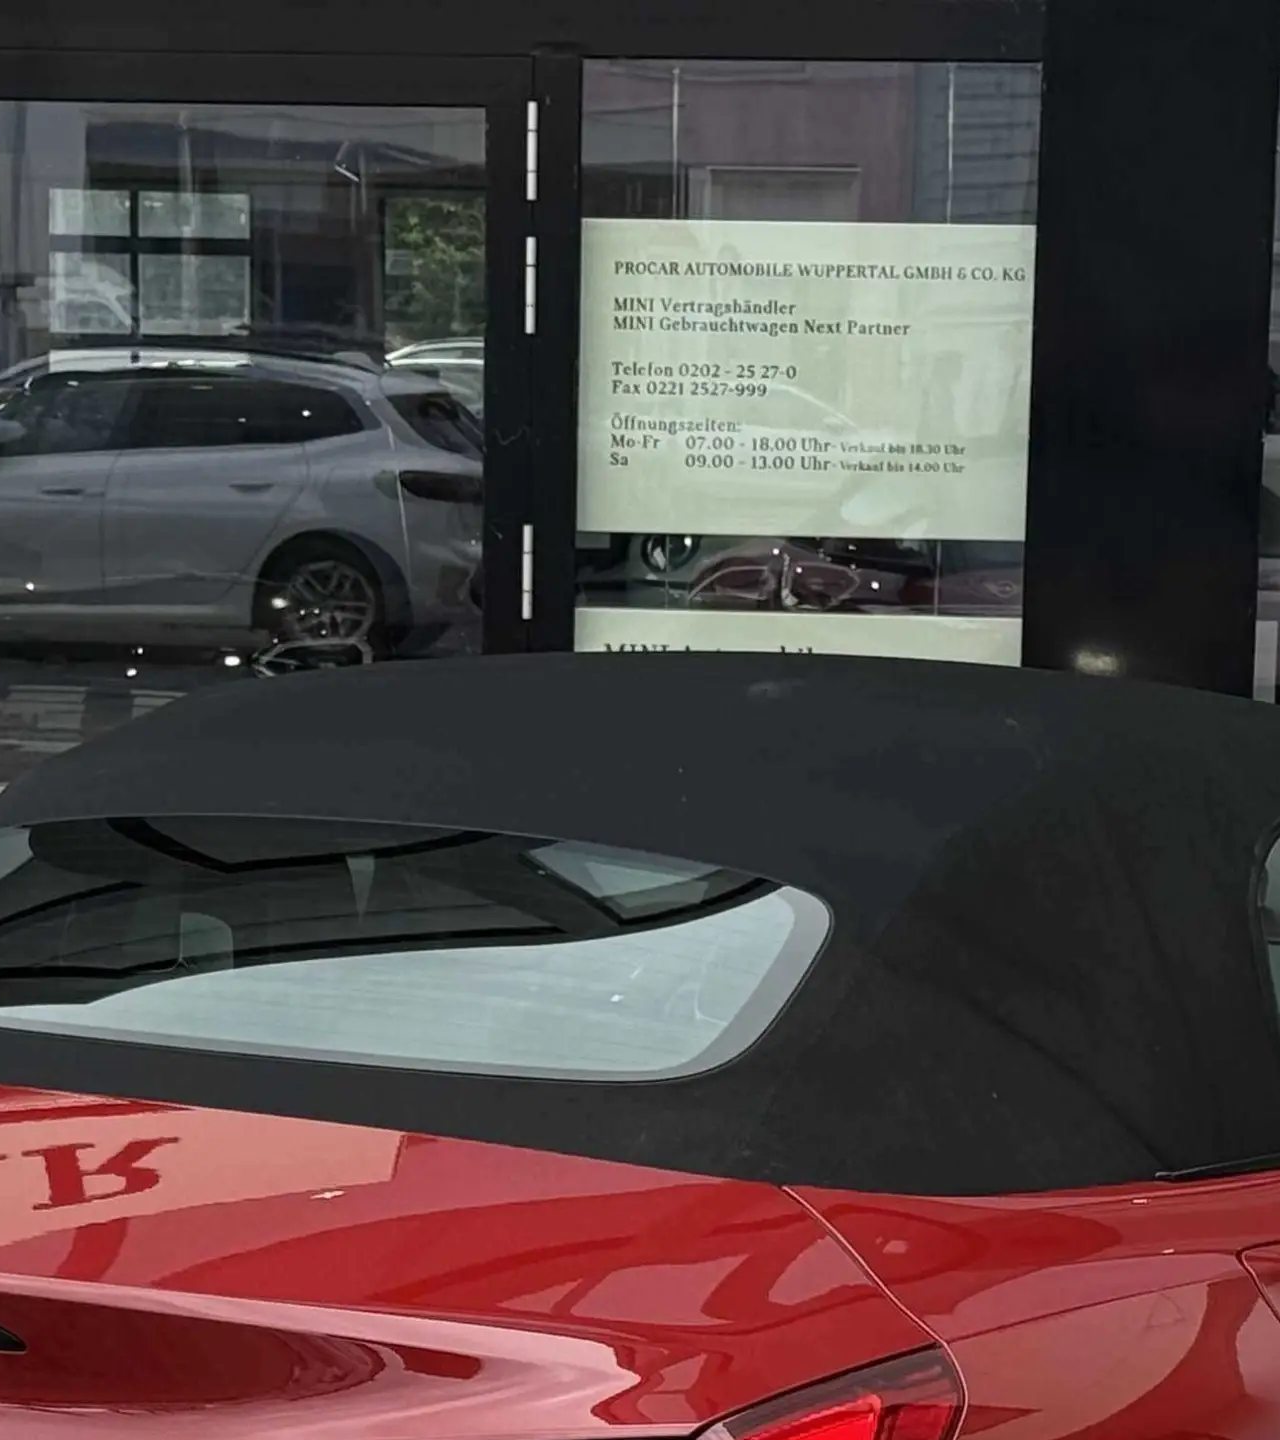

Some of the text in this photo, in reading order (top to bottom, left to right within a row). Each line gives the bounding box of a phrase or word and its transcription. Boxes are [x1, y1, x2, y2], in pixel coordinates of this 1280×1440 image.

[614, 261, 1026, 282] PROCAR AUTOMOBILE WUPPERTAL GMBH & CO. KG
[614, 297, 796, 316] MINI Vertragshändler
[614, 316, 911, 337] MINI Gebrauchtwagen Next Partner
[611, 361, 673, 377] Telefon
[678, 362, 720, 378] 0202
[736, 364, 755, 379] 25
[760, 365, 797, 379] 27-0
[611, 380, 767, 397] Fax 0221 2527-999
[611, 412, 741, 435] Öffnungszeiten:
[685, 436, 734, 450] 07.00
[751, 437, 797, 451] 18.00
[609, 452, 629, 466] Sa
[685, 454, 734, 468] 09.00
[751, 455, 795, 469] 13.00
[908, 462, 939, 473] 14.00
